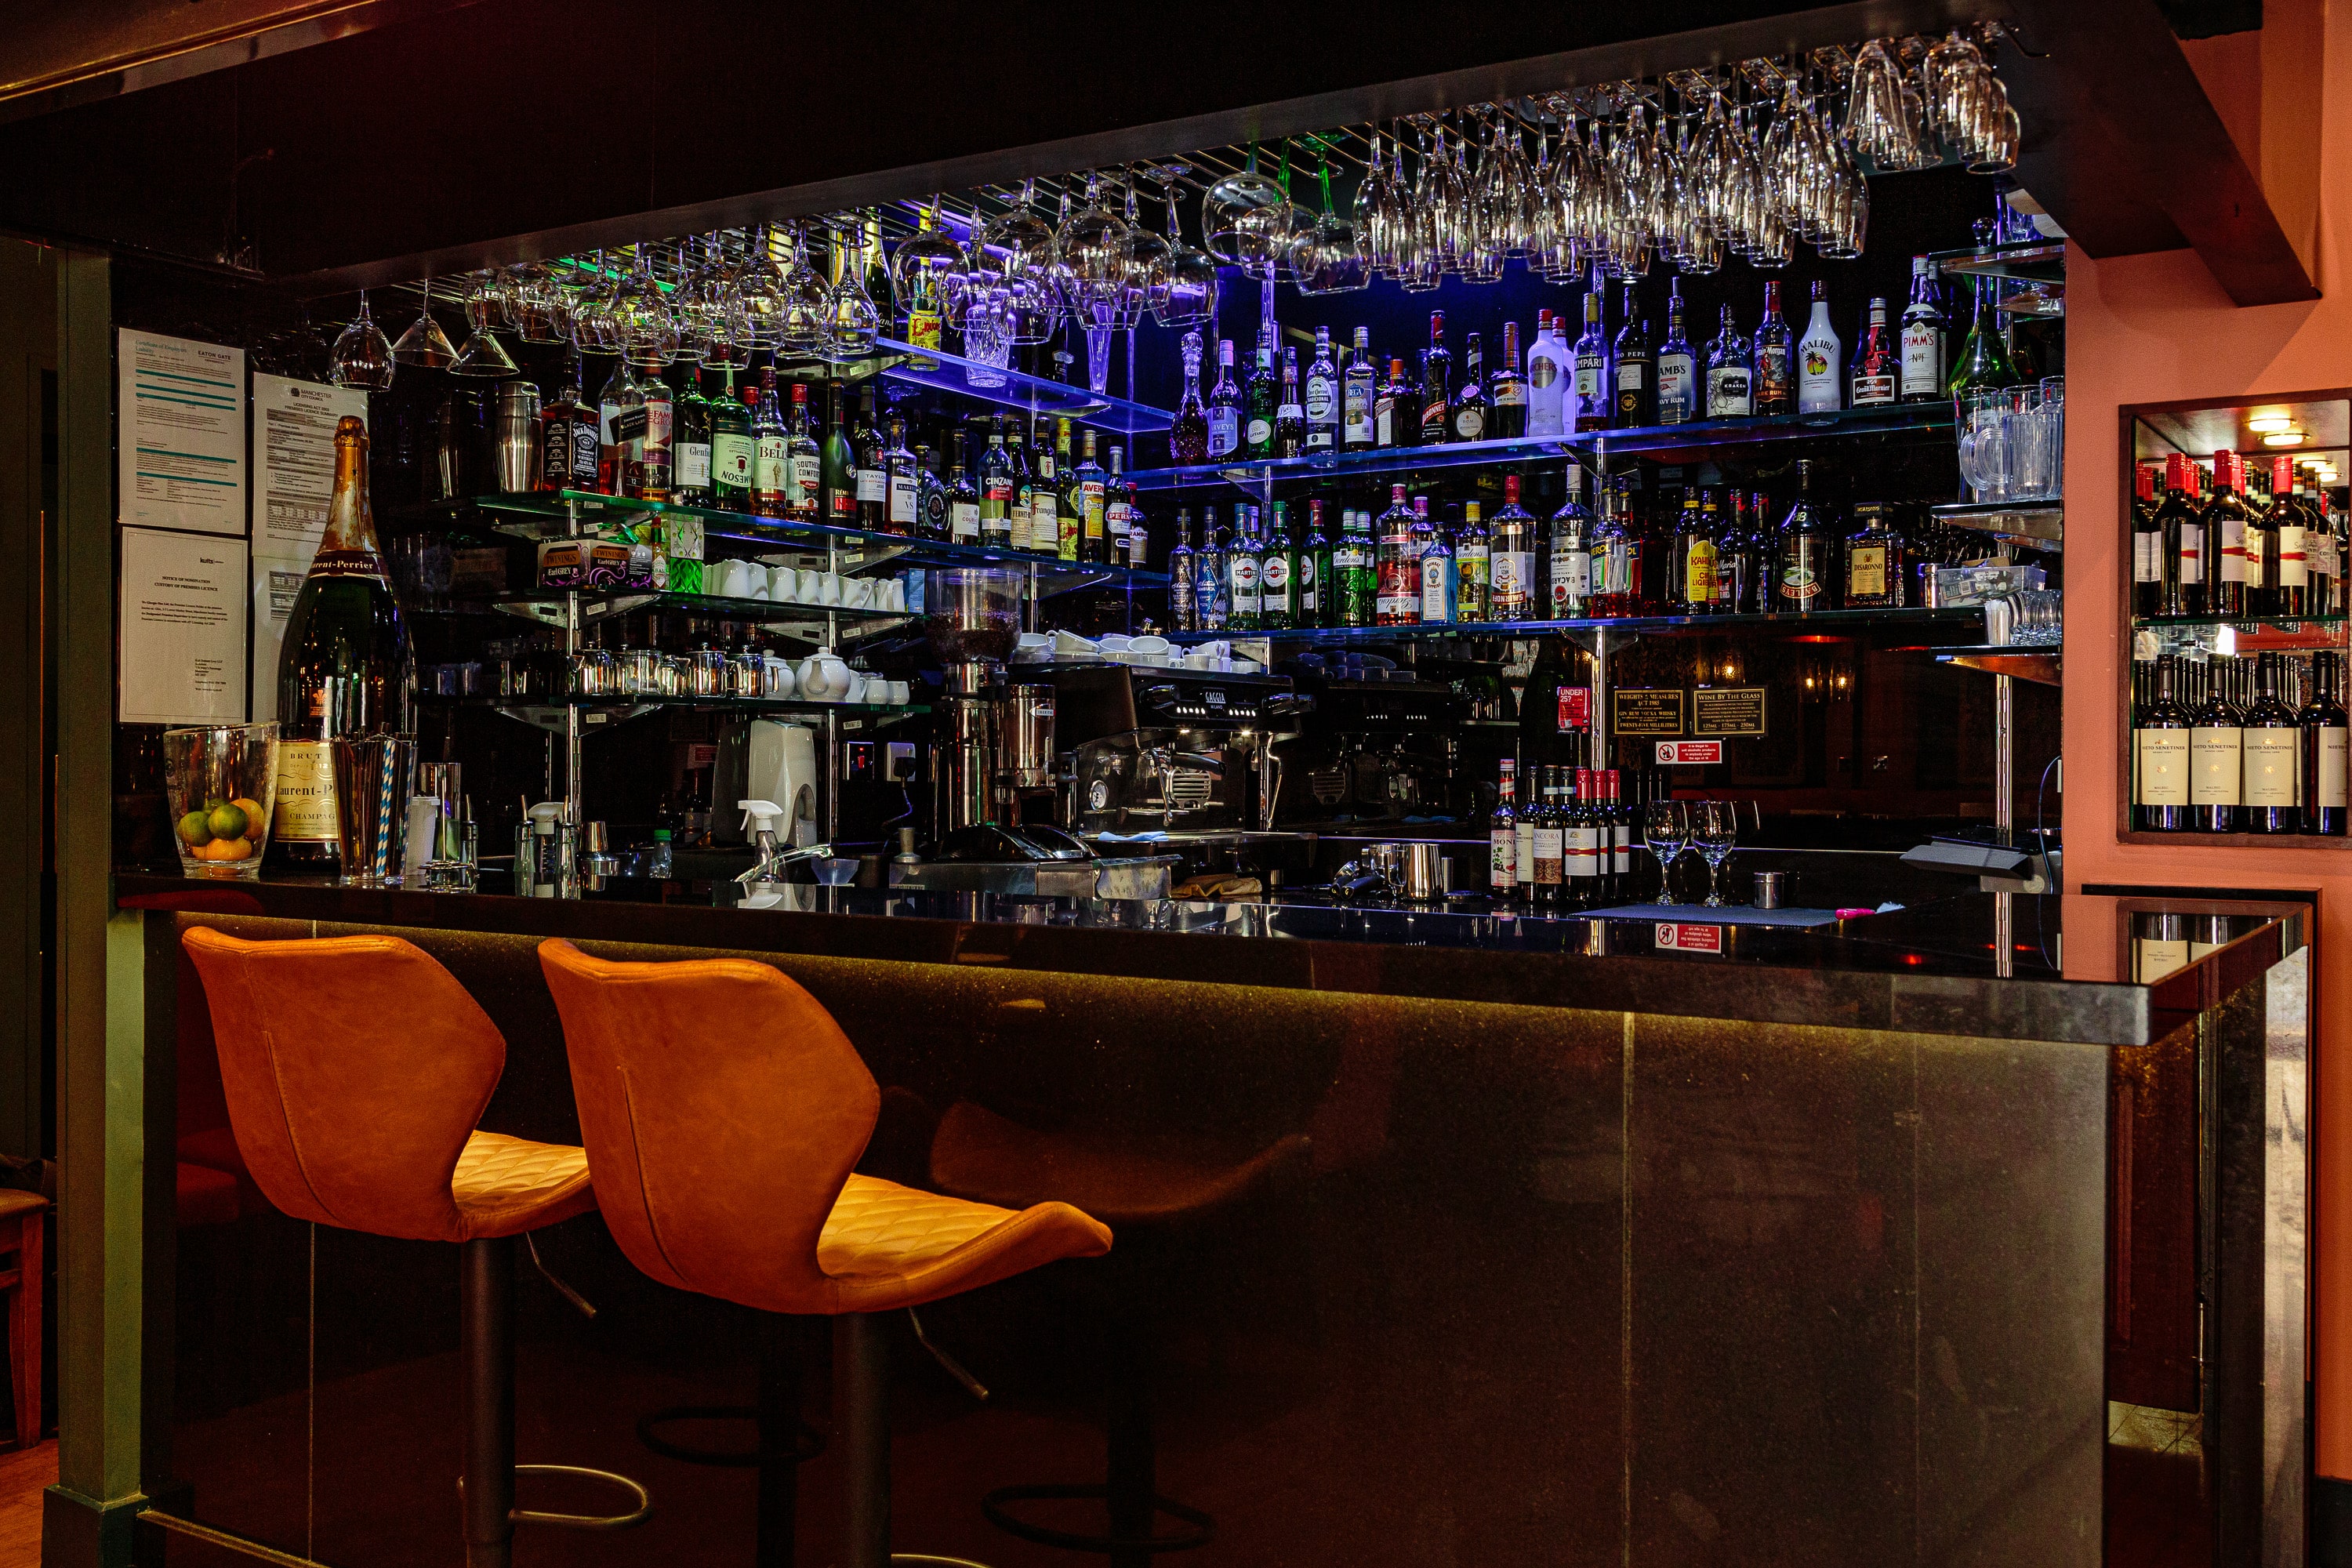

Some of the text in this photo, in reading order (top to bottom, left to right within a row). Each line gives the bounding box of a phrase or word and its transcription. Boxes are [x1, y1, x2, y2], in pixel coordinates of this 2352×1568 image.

[1904, 333, 1933, 348] PIMM'S
[1801, 340, 1836, 356] MALIBU
[301, 389, 332, 399] MANCHESTER
[573, 426, 584, 437] JACK
[906, 501, 913, 510] VS
[1457, 549, 1483, 558] Gordon's
[546, 554, 576, 564] TWININGS
[1719, 560, 1737, 570] Maria
[548, 568, 557, 576] Earl
[1782, 585, 1818, 597] BAILEYS
[1493, 593, 1523, 602] SMIRNOFF
[1205, 691, 1226, 703] GAGGIA
